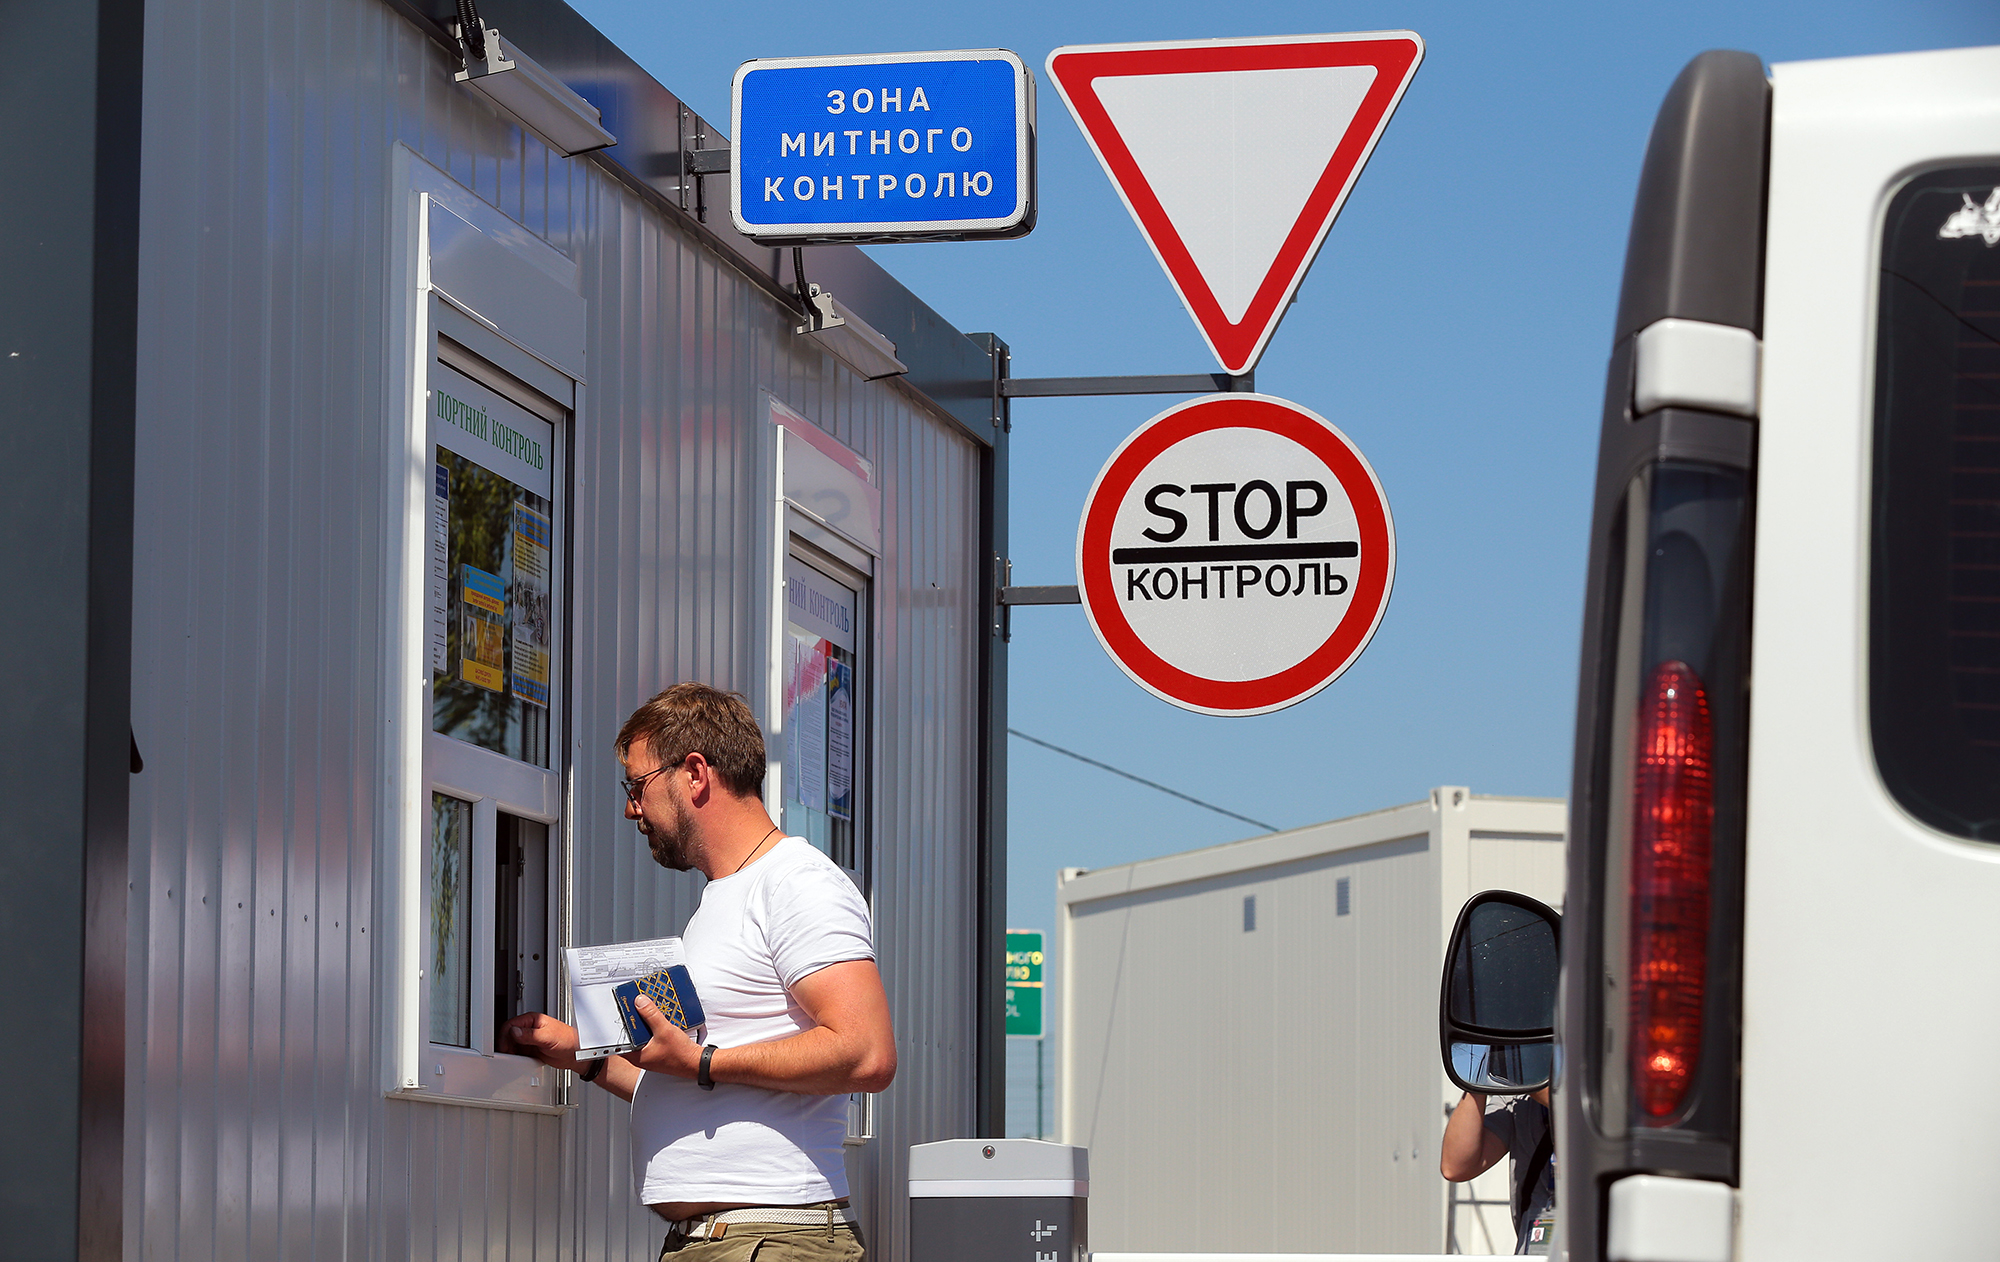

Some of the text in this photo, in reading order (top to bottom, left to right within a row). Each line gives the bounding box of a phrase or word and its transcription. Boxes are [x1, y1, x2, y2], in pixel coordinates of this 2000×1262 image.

[826, 86, 931, 114] ЗОНА
[781, 127, 973, 157] МИТНОГО
[764, 171, 993, 202] КОНТРОЛЮ
[437, 389, 544, 471] ПОРТНИЙ КОНТРОЛЬ
[1141, 479, 1328, 543] STOP
[1127, 562, 1348, 601] КОНТРОЛЬ
[789, 576, 850, 633] НИЙ КОНТРОЛЬ
